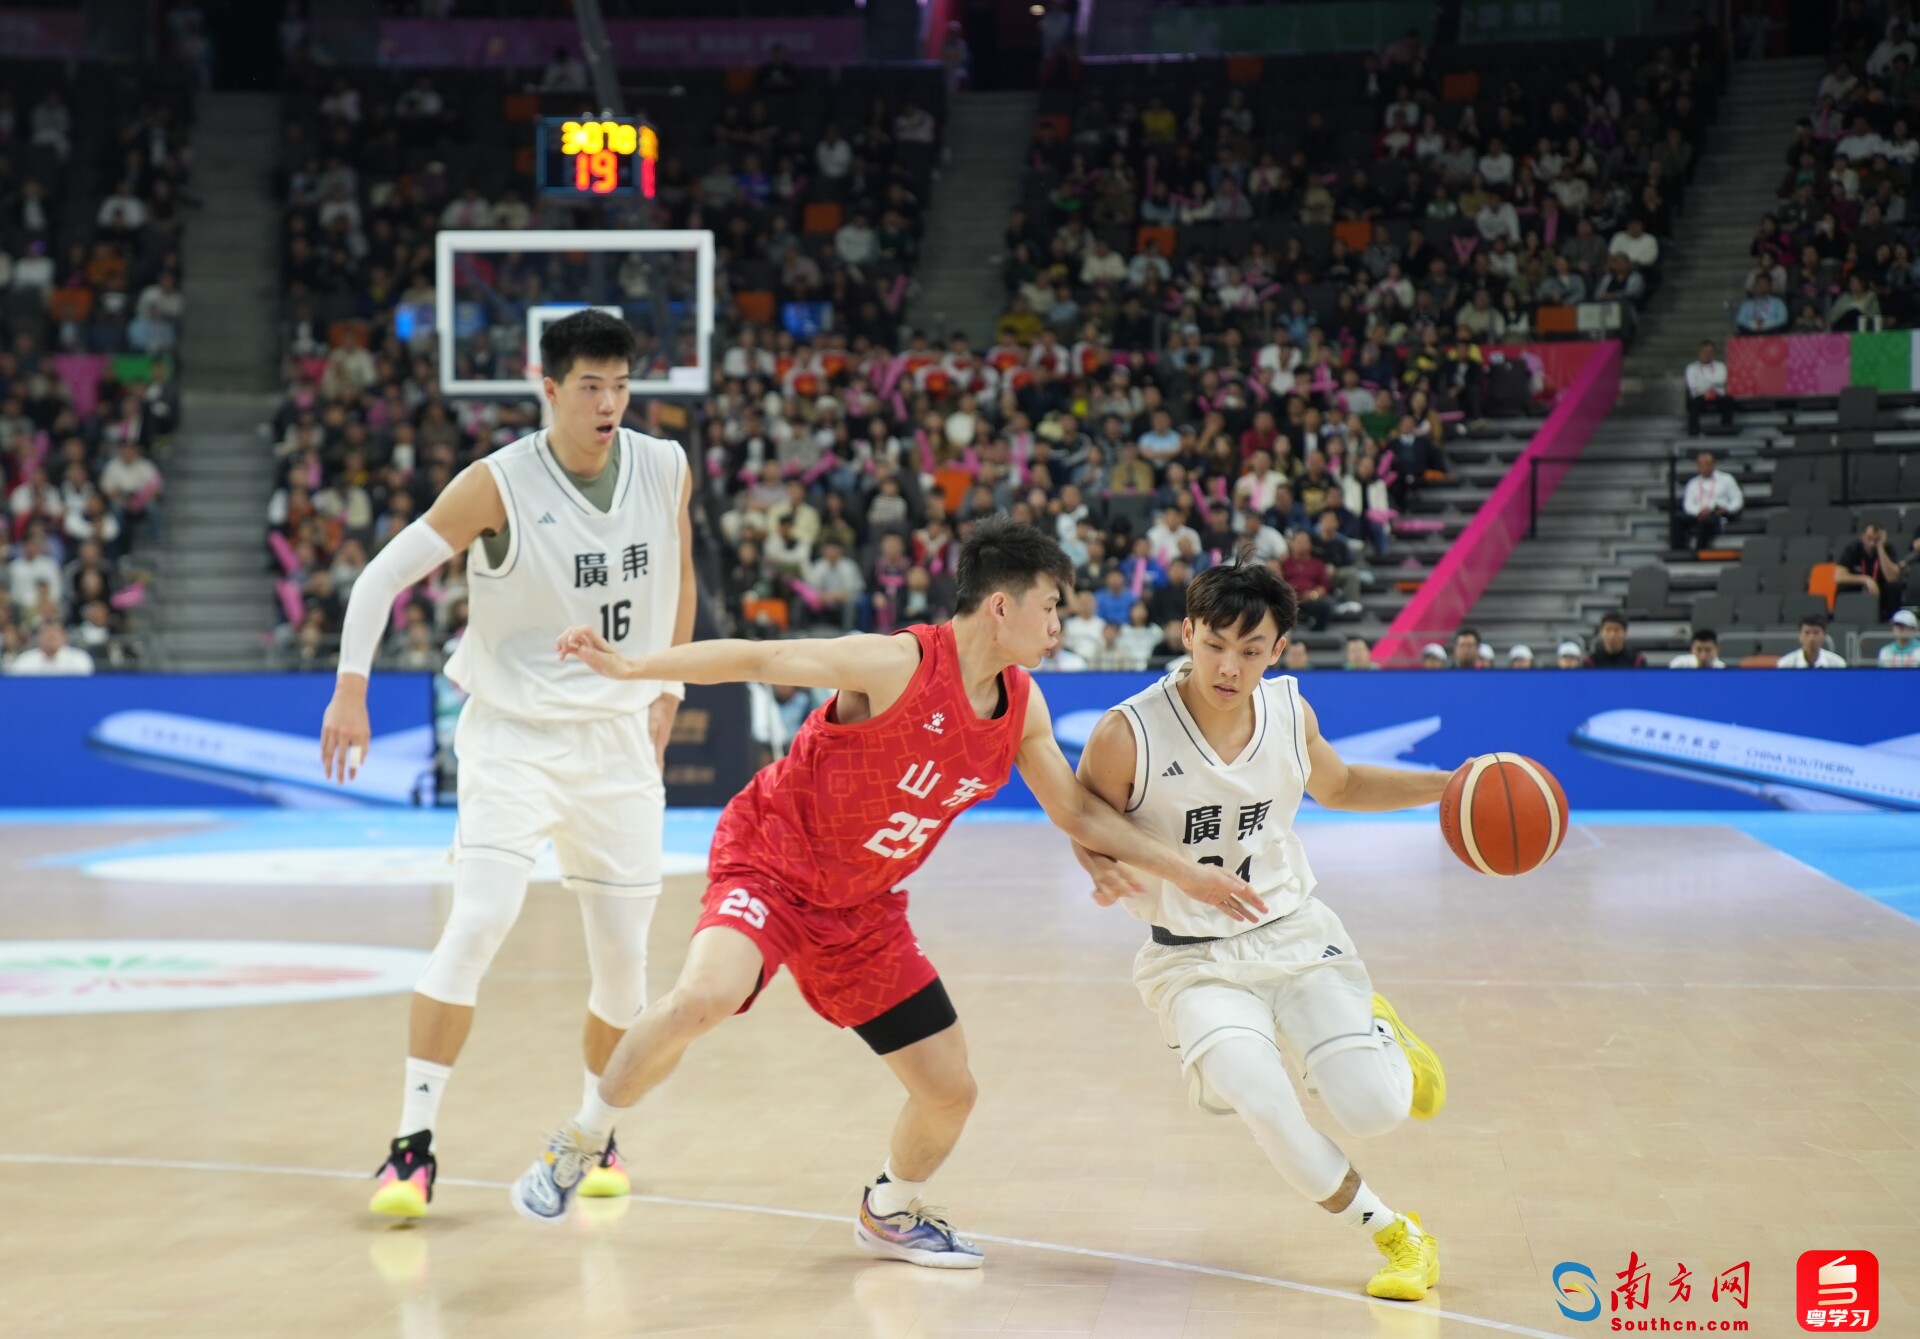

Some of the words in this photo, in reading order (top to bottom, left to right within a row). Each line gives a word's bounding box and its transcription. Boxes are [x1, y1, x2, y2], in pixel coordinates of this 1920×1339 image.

[575, 150, 618, 194] 19
[574, 543, 649, 589] 廣東
[600, 599, 632, 643] 16
[922, 723, 944, 735] KELME
[862, 811, 942, 859] 25
[1182, 799, 1273, 845] 廣東
[717, 887, 770, 930] 25
